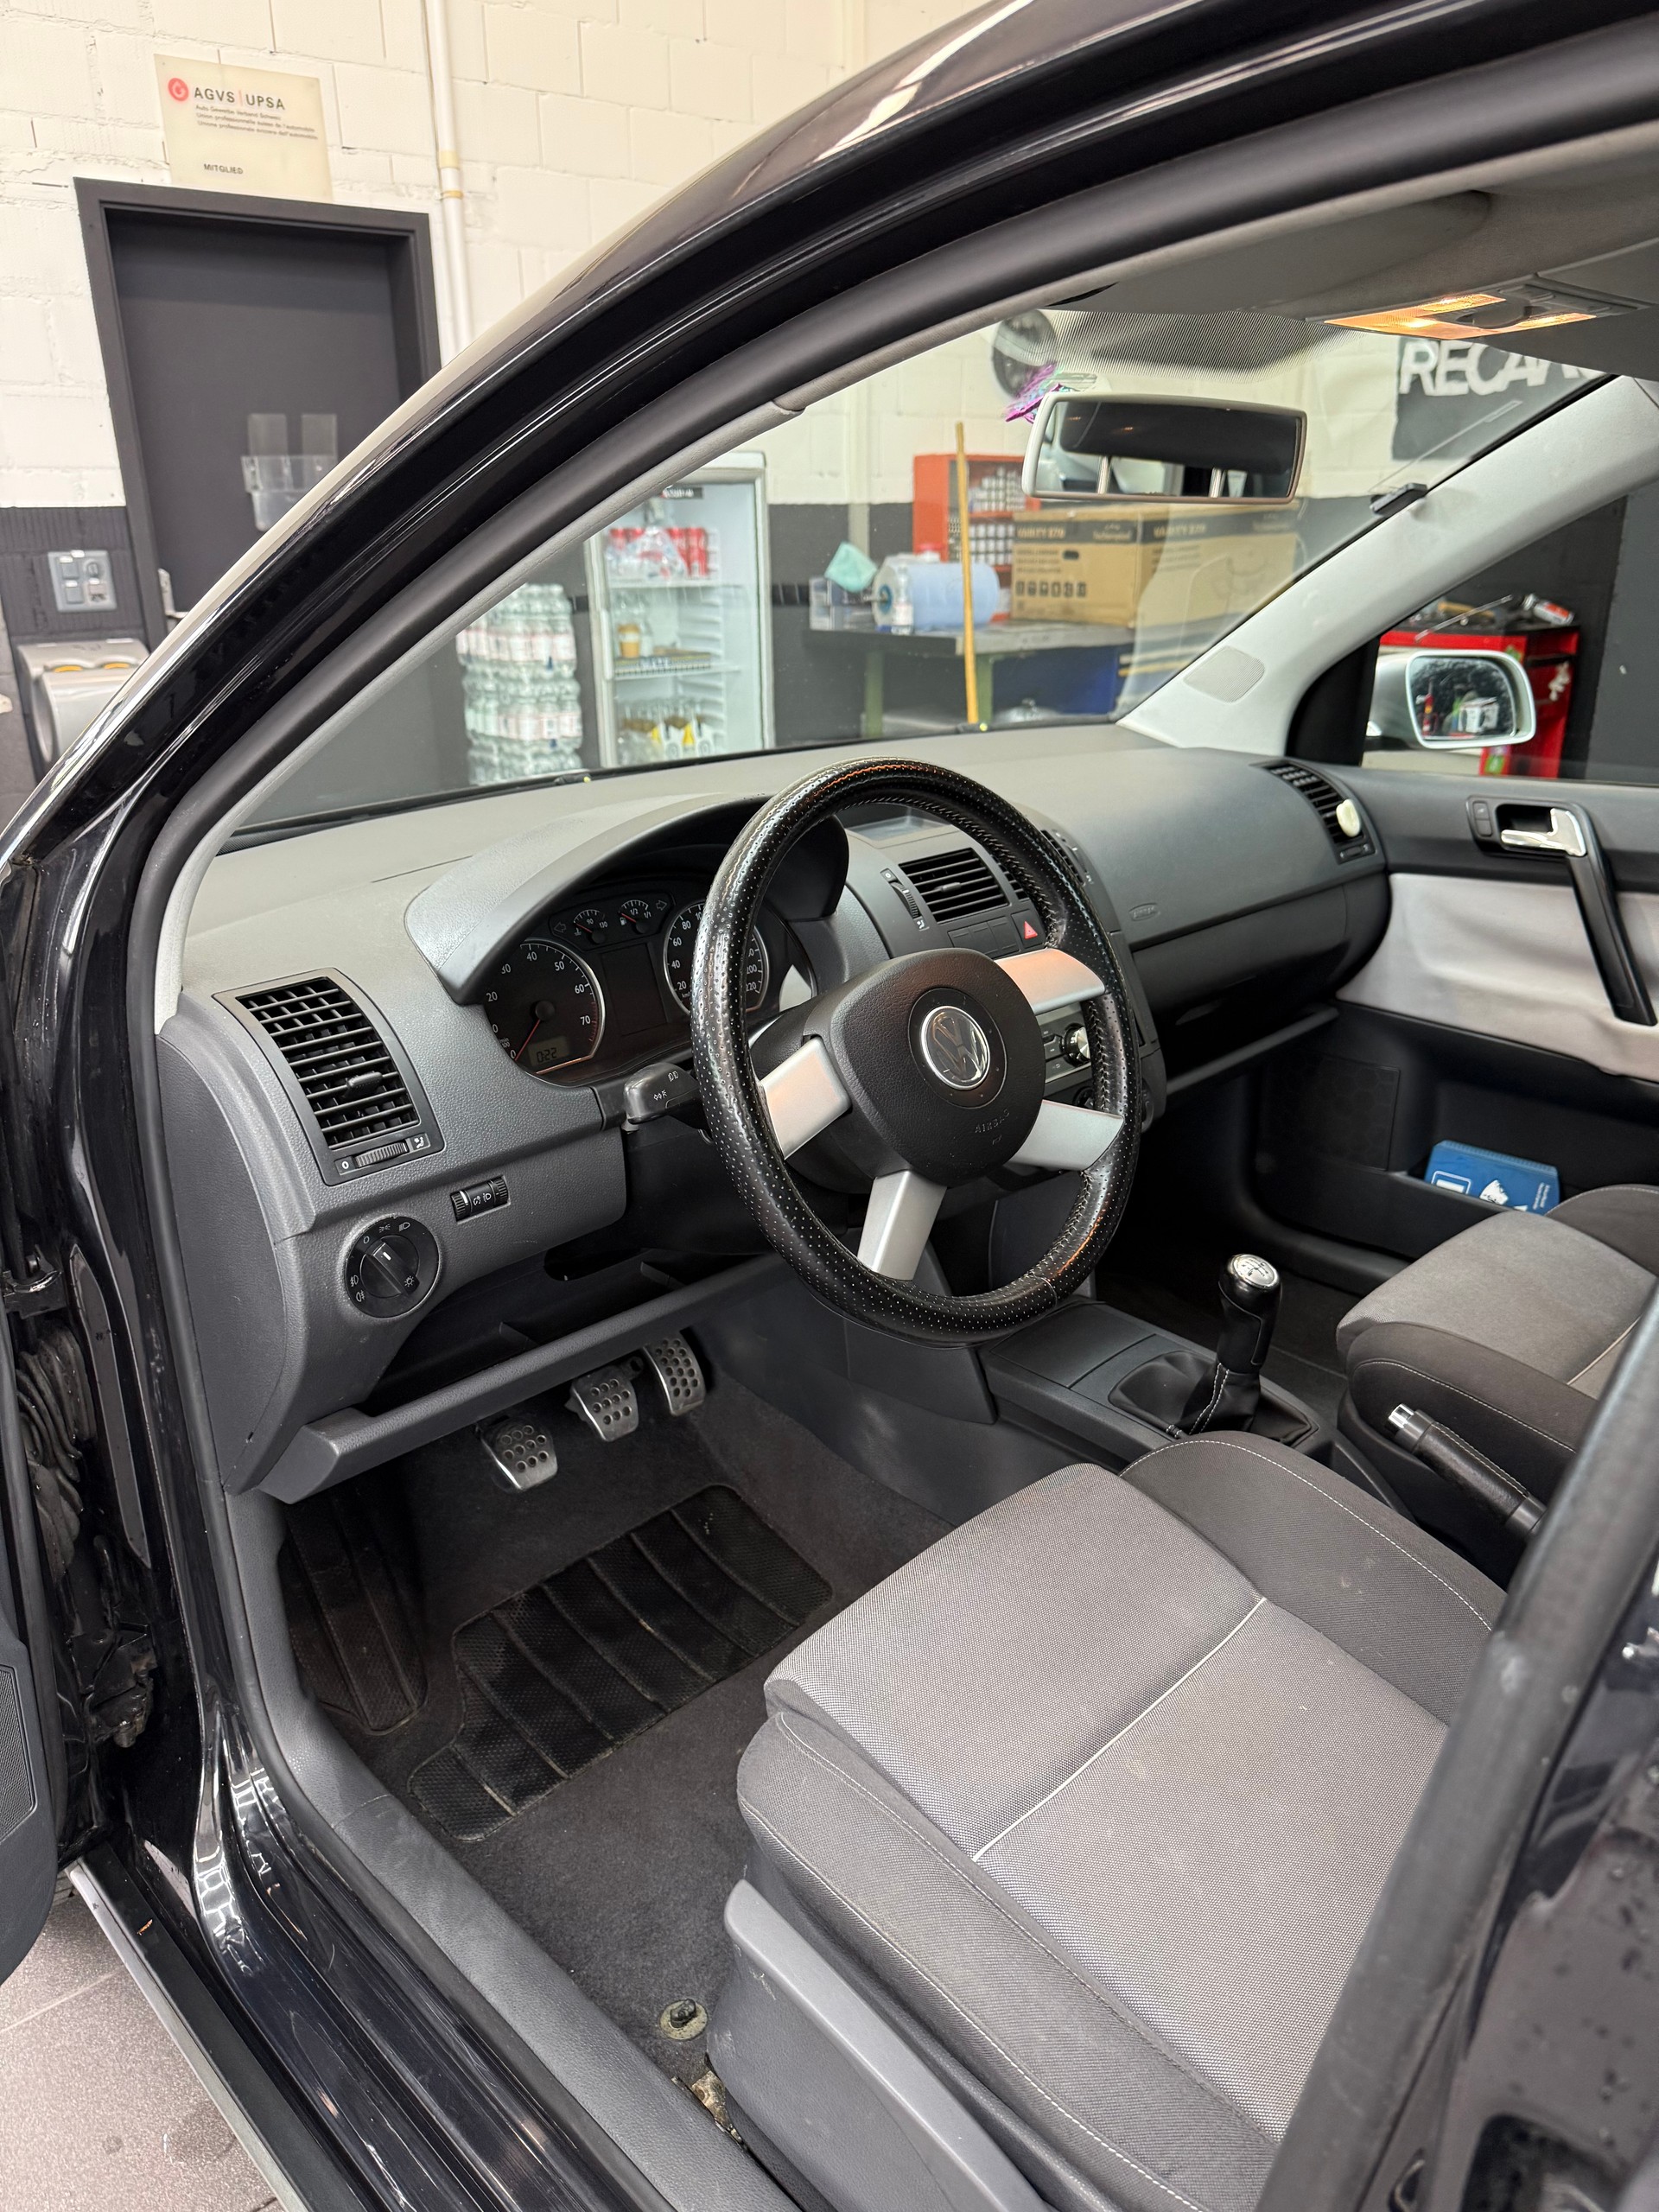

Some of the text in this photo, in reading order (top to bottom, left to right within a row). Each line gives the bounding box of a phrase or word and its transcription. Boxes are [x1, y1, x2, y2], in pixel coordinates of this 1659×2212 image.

[194, 86, 285, 111] AGVS UPSA
[203, 163, 244, 175] MITGLIED
[1399, 338, 1605, 397] RECA
[682, 920, 691, 930] 80
[672, 937, 683, 947] 60
[526, 951, 537, 962] 40
[501, 963, 512, 975] 30
[554, 961, 565, 971] 50
[671, 959, 681, 969] 40
[575, 983, 585, 995] 60
[677, 980, 687, 990] 20
[486, 991, 499, 1002] 20
[580, 1015, 591, 1026] 70
[510, 1049, 517, 1059] 0
